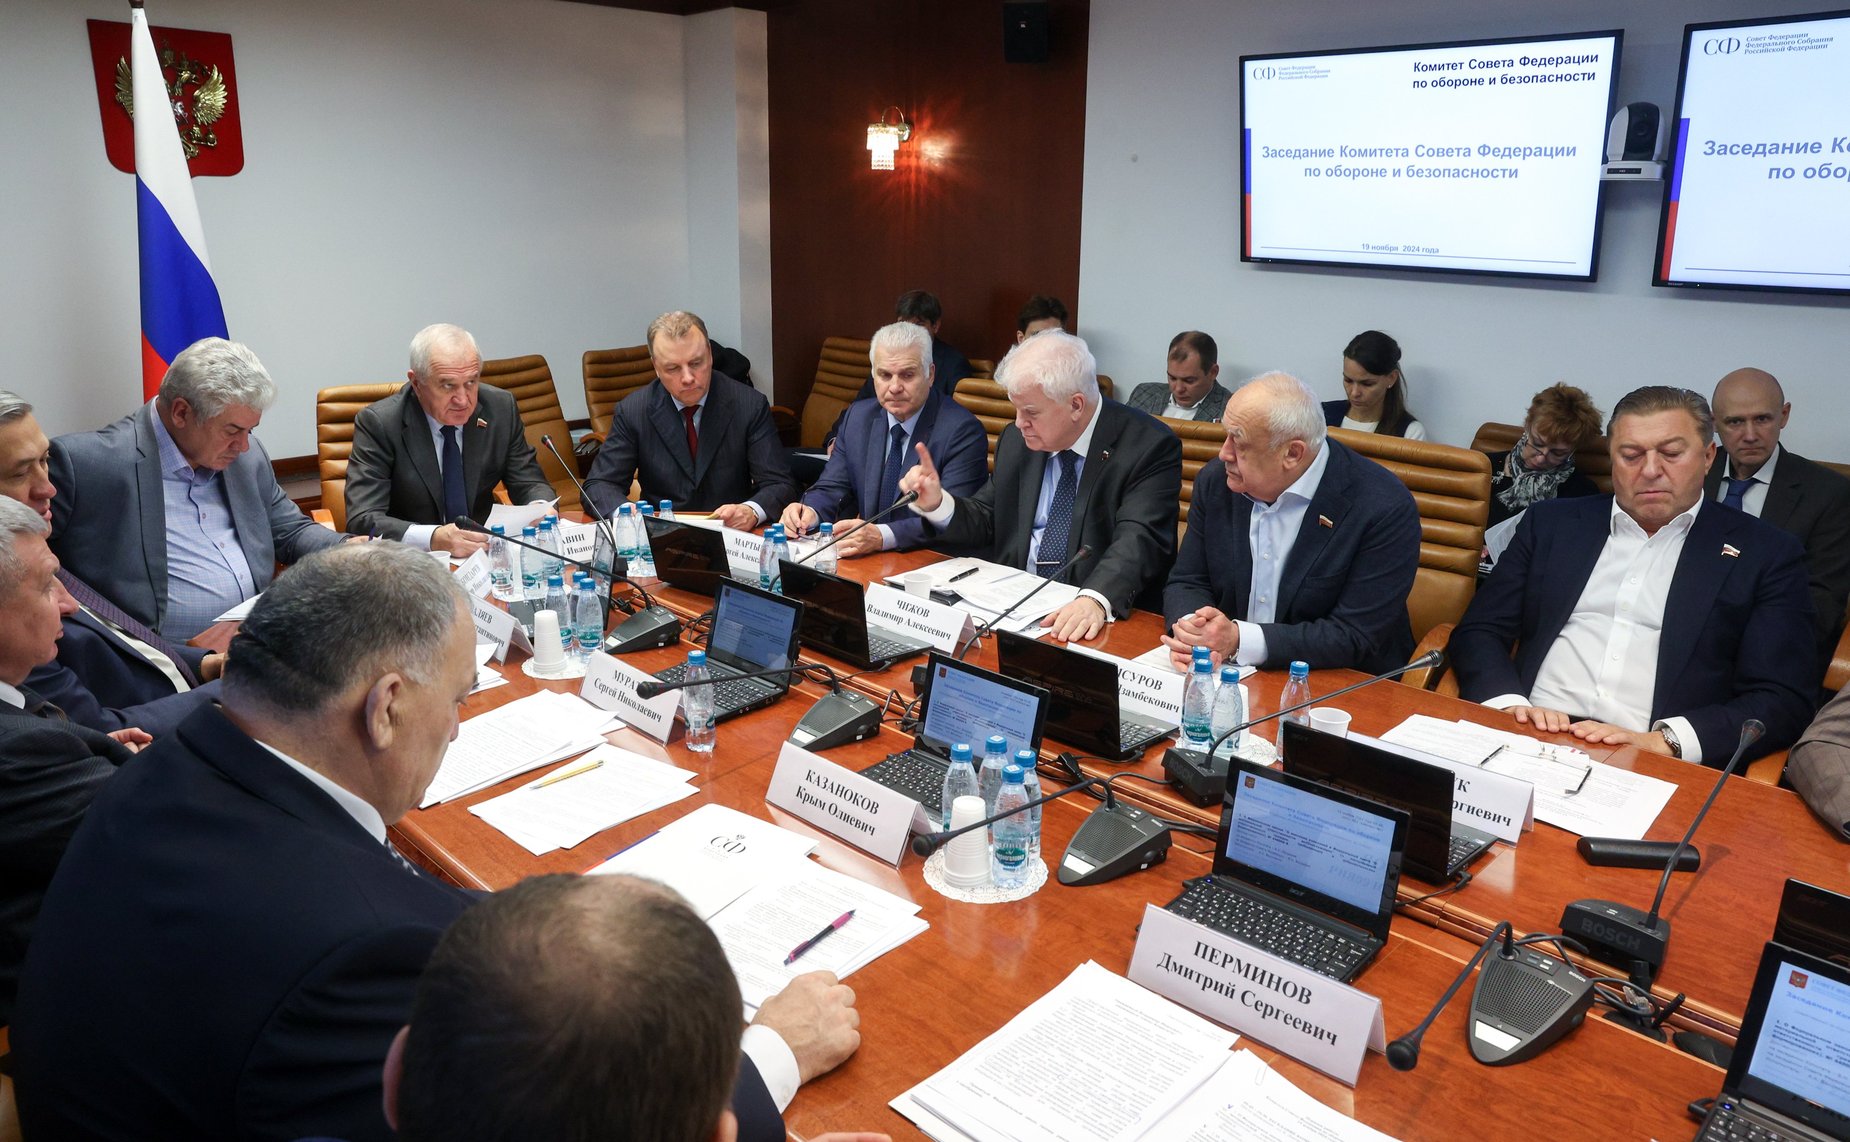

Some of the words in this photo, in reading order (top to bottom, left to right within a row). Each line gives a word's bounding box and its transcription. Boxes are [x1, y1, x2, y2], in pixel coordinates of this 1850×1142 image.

[1704, 37, 1741, 55] СФ
[1745, 40, 1795, 48] Федерального
[1797, 37, 1834, 45] Собрания
[1768, 33, 1808, 41] Федерации
[1744, 46, 1785, 54] Российской
[1787, 44, 1828, 52] Федерации
[1413, 61, 1464, 73] Комитет
[1468, 58, 1514, 70] Совета
[1519, 54, 1599, 68] Федерации
[1253, 66, 1276, 80] СФ
[1412, 79, 1427, 89] по
[1431, 77, 1485, 89] обороне
[1488, 77, 1496, 86] и
[1500, 72, 1596, 85] безопасности
[1262, 146, 1335, 160] Заседание
[1340, 145, 1409, 158] Комитета
[1415, 144, 1471, 158] Совета
[1477, 144, 1577, 160] Федерации
[1703, 140, 1823, 158] Заседание
[1304, 168, 1321, 178] по
[1325, 165, 1387, 180] обороне
[1392, 169, 1401, 177] и
[1406, 165, 1519, 178] безопасности
[1768, 167, 1796, 179] по
[1362, 243, 1370, 251] 19
[1371, 244, 1398, 252] ноября
[1402, 245, 1420, 253] 2024
[734, 537, 761, 551] МАРТЫ
[897, 599, 930, 618] ЧИЖОВ
[866, 604, 904, 625] Владимир
[905, 618, 952, 640] Алексеевич
[1118, 668, 1163, 691] СУРОВ
[594, 677, 617, 698] Сергей
[617, 690, 662, 723] Николаевич
[805, 769, 880, 815] КАЗАНОКОВ
[795, 785, 826, 811] Крым
[828, 802, 876, 837] Олиевич
[1581, 917, 1641, 949] BOSCH
[1194, 941, 1313, 1005] ПЕРМИНОВ
[1156, 952, 1236, 1000] Дмитрий
[1241, 990, 1338, 1046] Сергеевич
